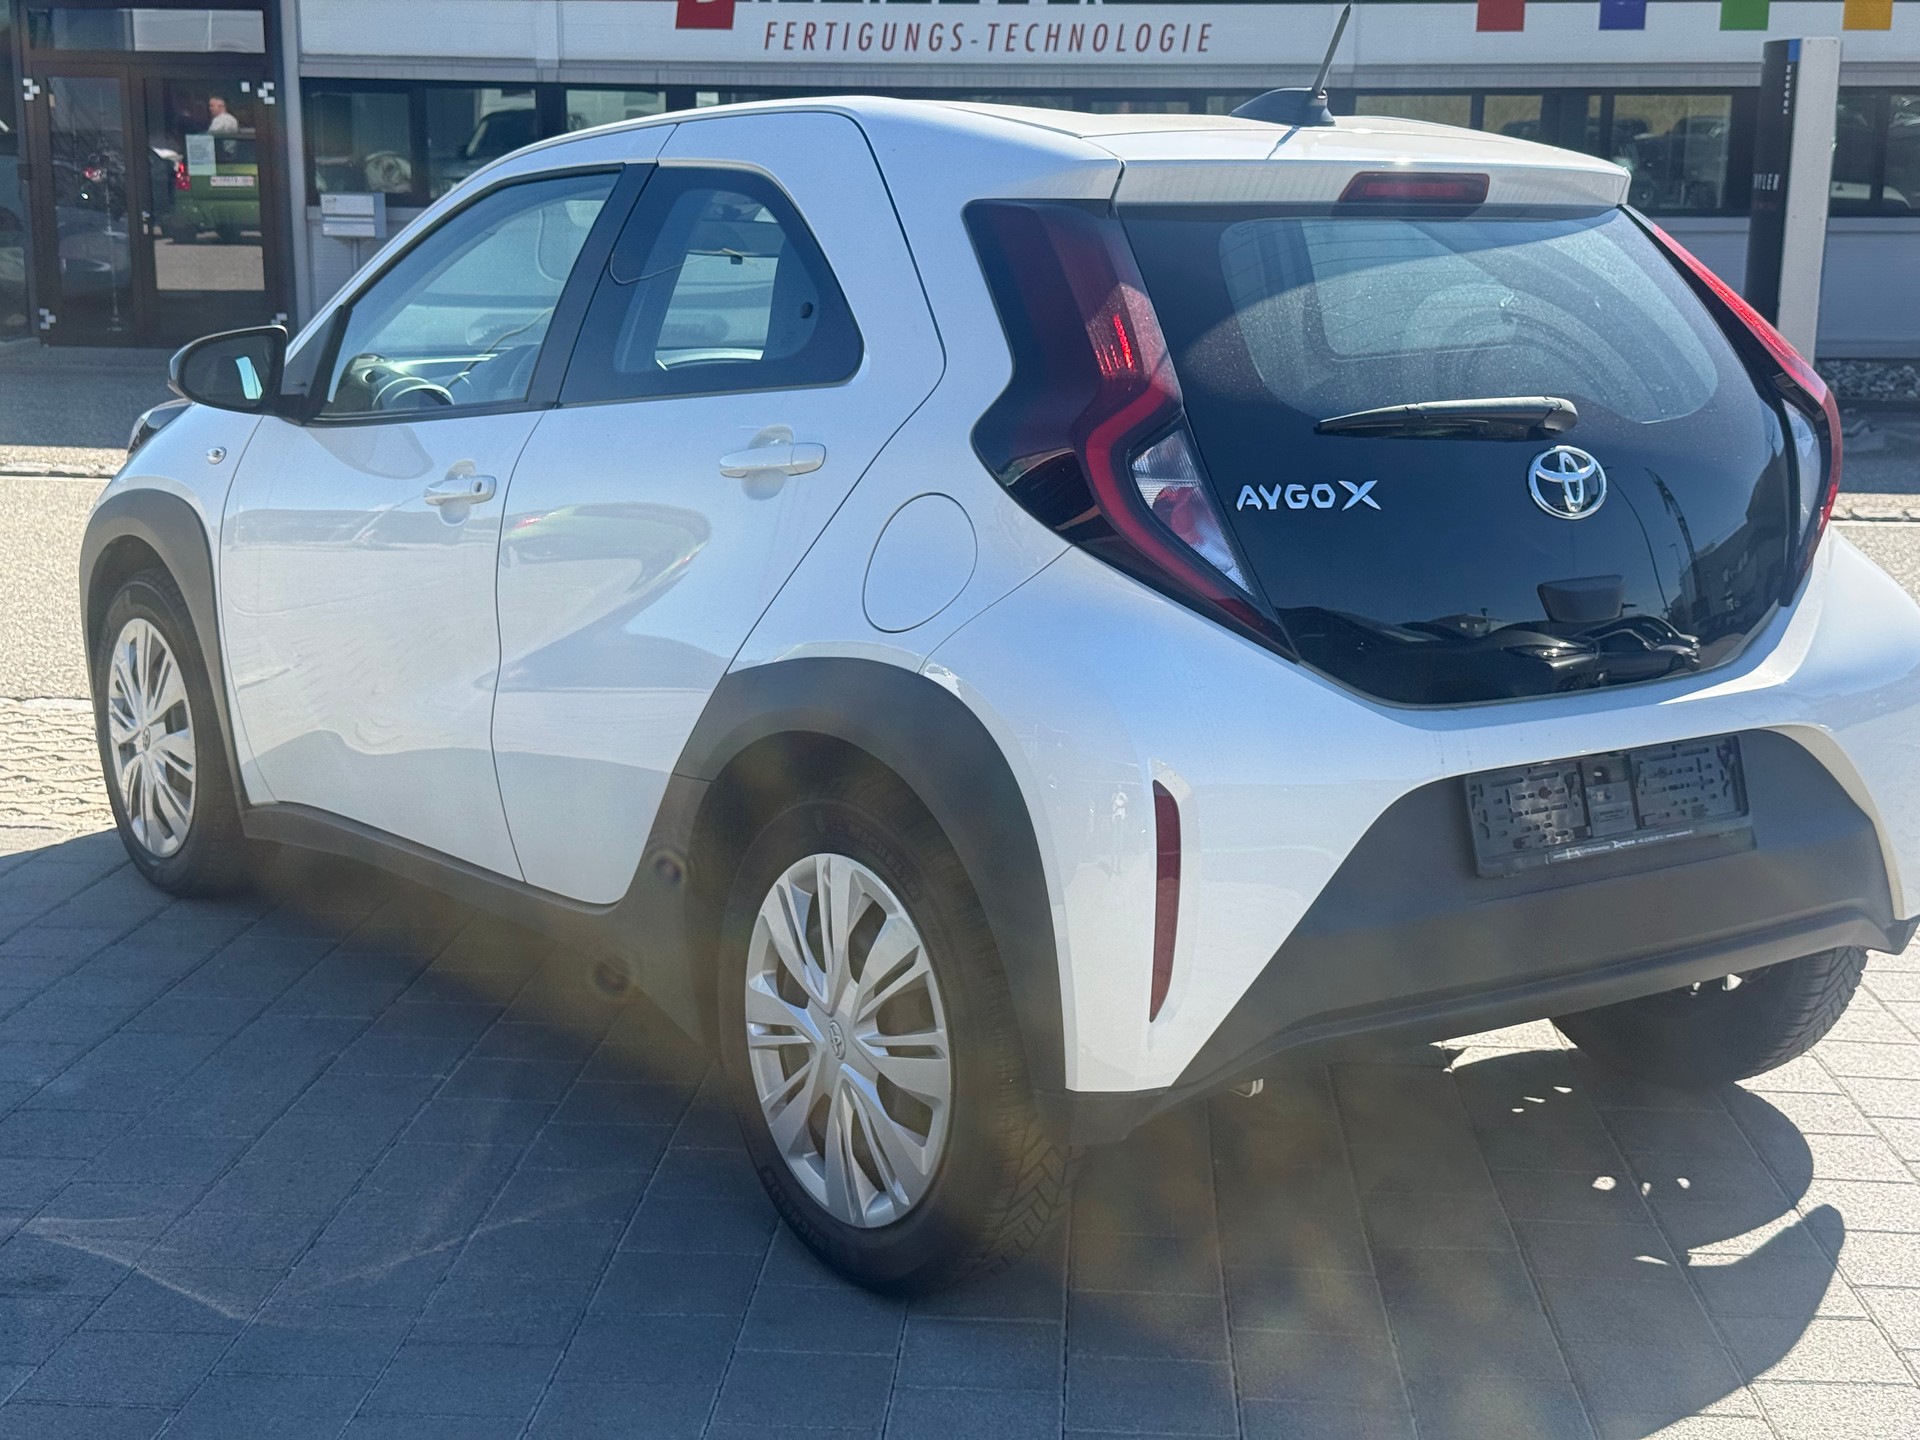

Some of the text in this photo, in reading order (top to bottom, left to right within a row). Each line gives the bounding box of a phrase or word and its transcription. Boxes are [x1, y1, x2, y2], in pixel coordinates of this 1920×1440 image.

[763, 21, 1213, 53] FERTIGUNGS-TECHNOLOGIE
[1236, 479, 1382, 511] AYGO X
